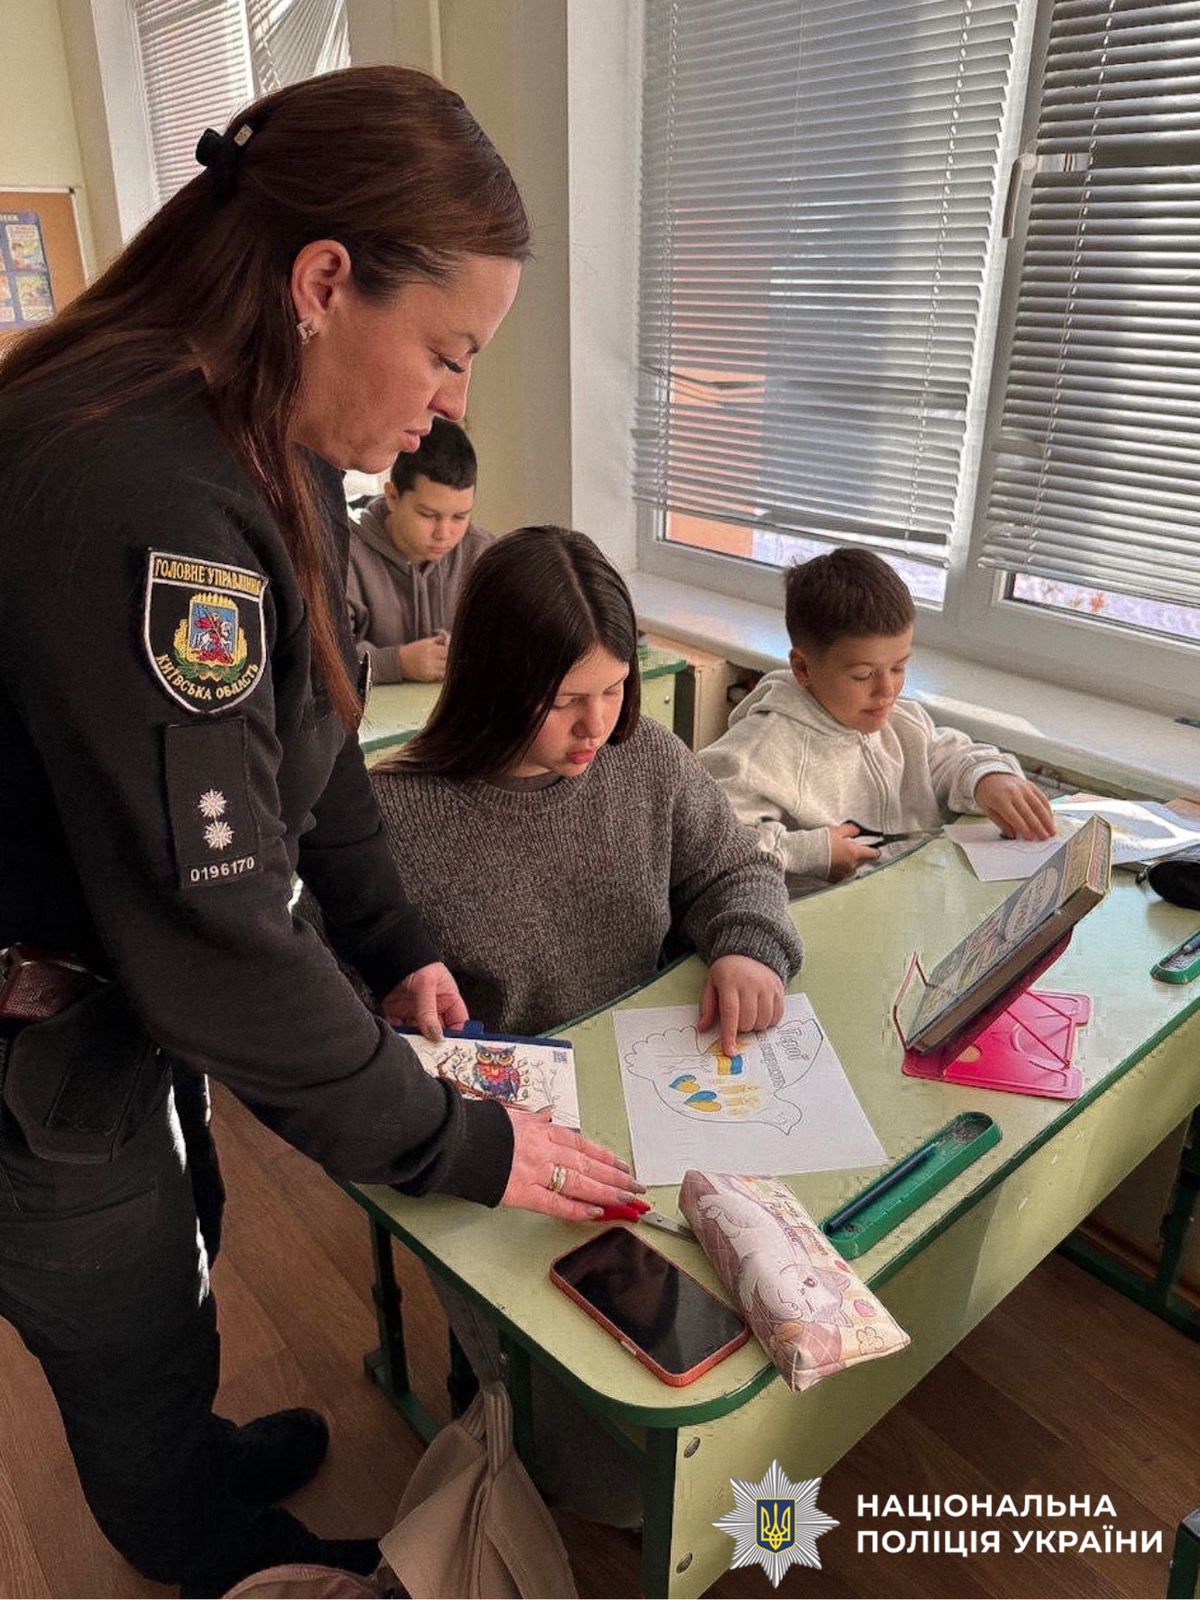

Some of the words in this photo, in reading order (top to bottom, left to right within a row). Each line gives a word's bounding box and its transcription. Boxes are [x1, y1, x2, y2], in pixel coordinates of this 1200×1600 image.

[154, 558, 206, 583] ГОЛОВНЕ
[155, 653, 213, 700] КИЇВСЬКА
[215, 663, 260, 699] ОБЛАСТЬ
[190, 856, 256, 882] 0196170
